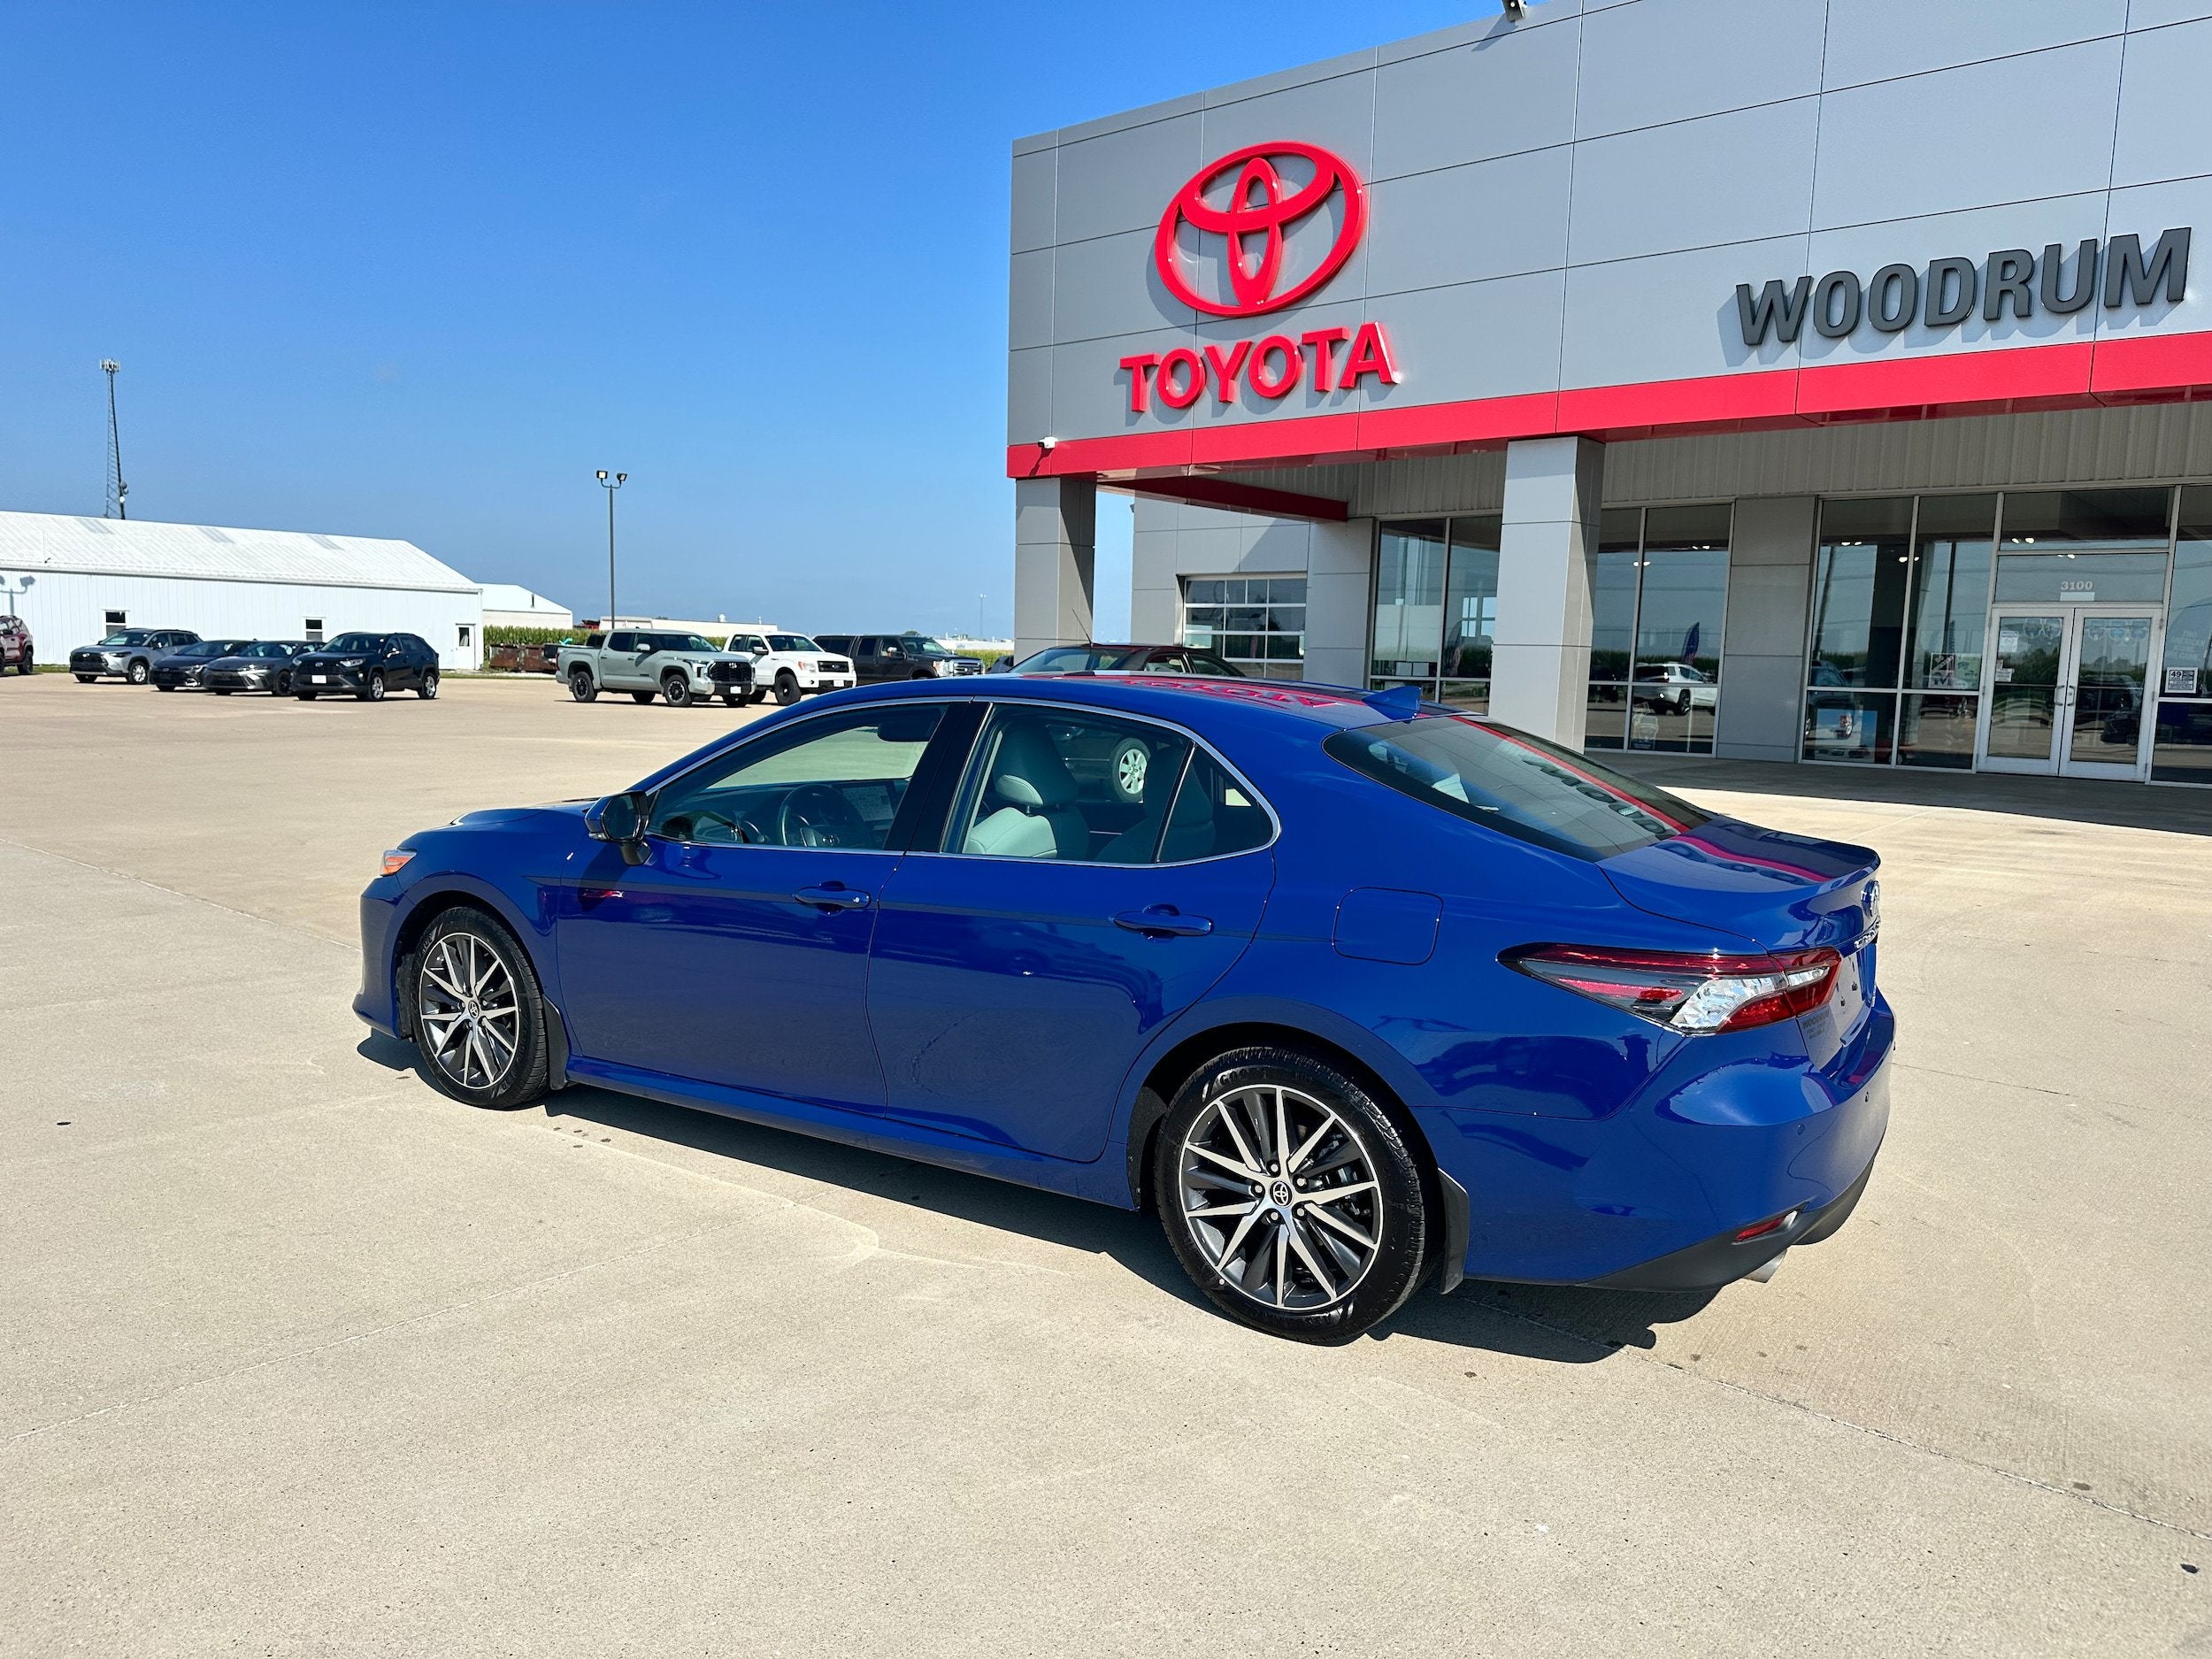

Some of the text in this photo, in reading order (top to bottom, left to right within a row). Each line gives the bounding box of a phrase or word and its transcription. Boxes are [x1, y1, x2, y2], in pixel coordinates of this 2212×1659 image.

[1735, 227, 2193, 346] WOODRUM
[1119, 321, 1399, 412] TOYOTA
[2061, 580, 2093, 591] 3100
